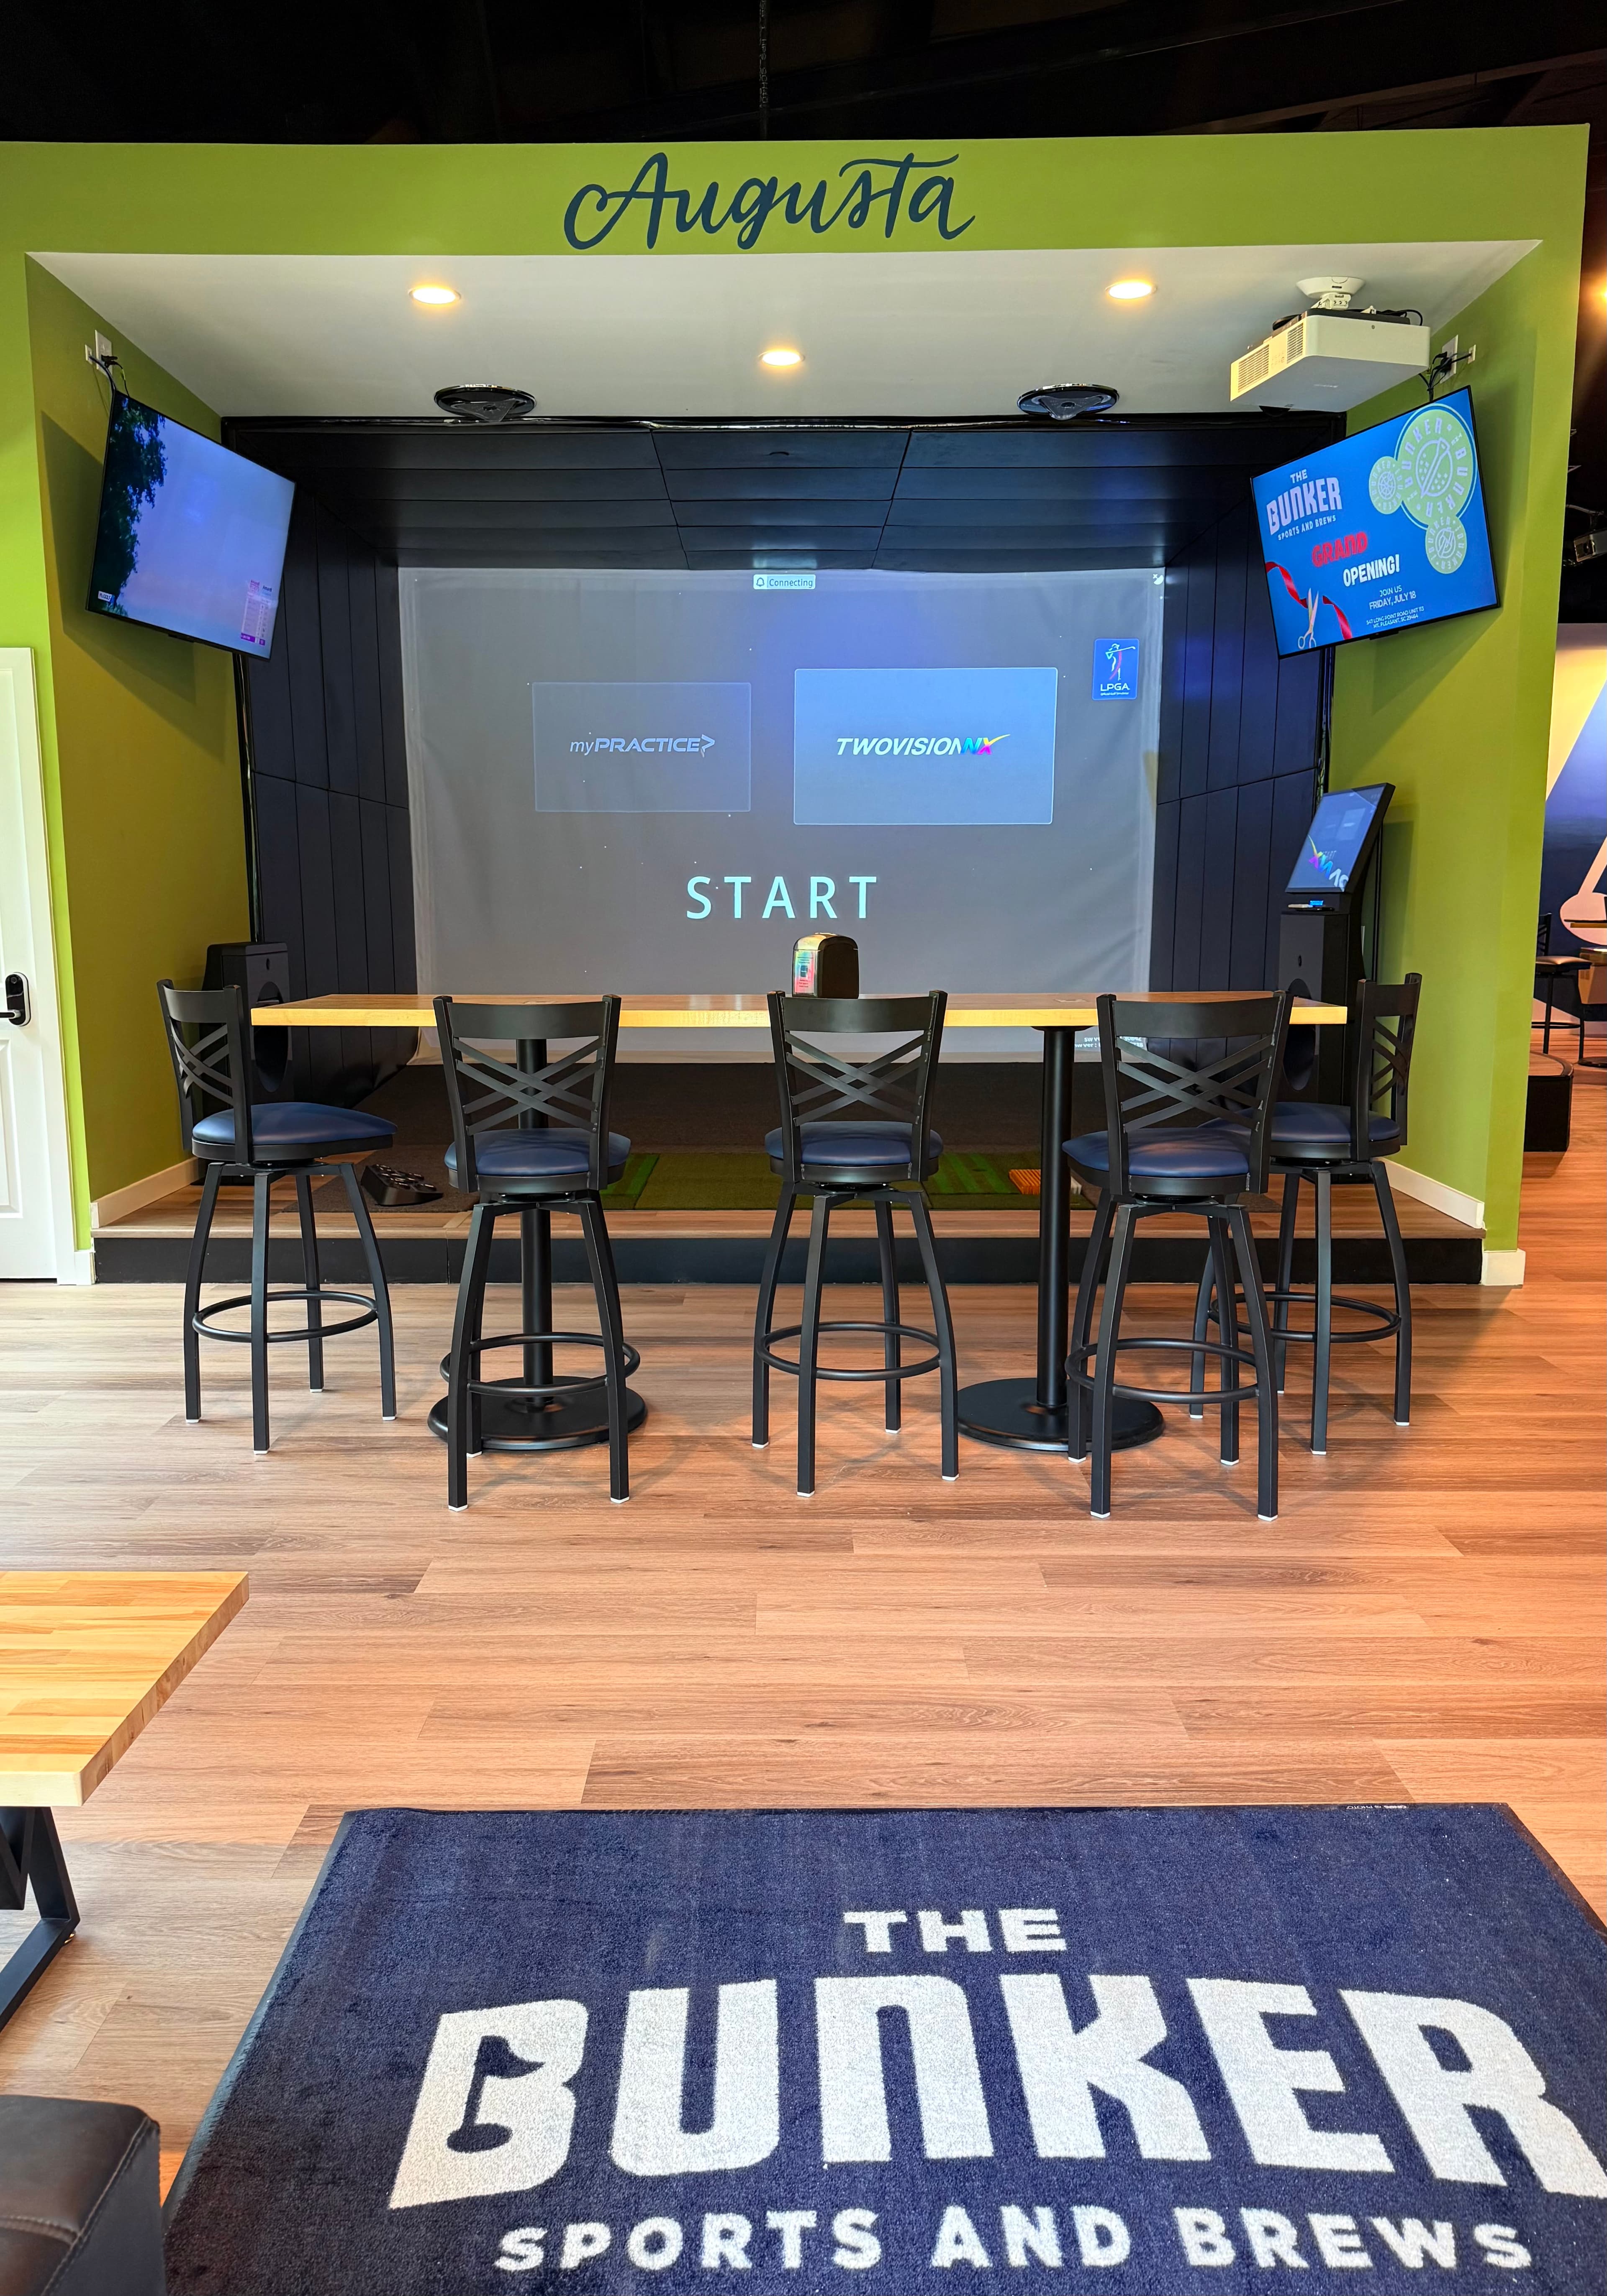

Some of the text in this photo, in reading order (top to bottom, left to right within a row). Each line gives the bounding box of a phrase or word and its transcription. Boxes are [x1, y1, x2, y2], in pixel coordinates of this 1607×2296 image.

[564, 152, 975, 250] Augusta
[1290, 469, 1308, 484] THE
[1266, 477, 1343, 536] BUNKER
[1278, 515, 1336, 541] SPORTS AND BREWS
[1312, 531, 1368, 568] GRAND
[769, 579, 813, 588] Connecting
[1343, 554, 1400, 587] OPENING!
[1369, 590, 1417, 610] FRIDAY, JULY 18
[1379, 587, 1393, 597] JOIN
[1100, 682, 1129, 691] LPGA
[686, 876, 877, 919] START
[843, 1908, 1067, 1953] THE
[390, 1973, 1607, 2209] BUNKER
[495, 2204, 1533, 2272] SPORTS AND BREWS
